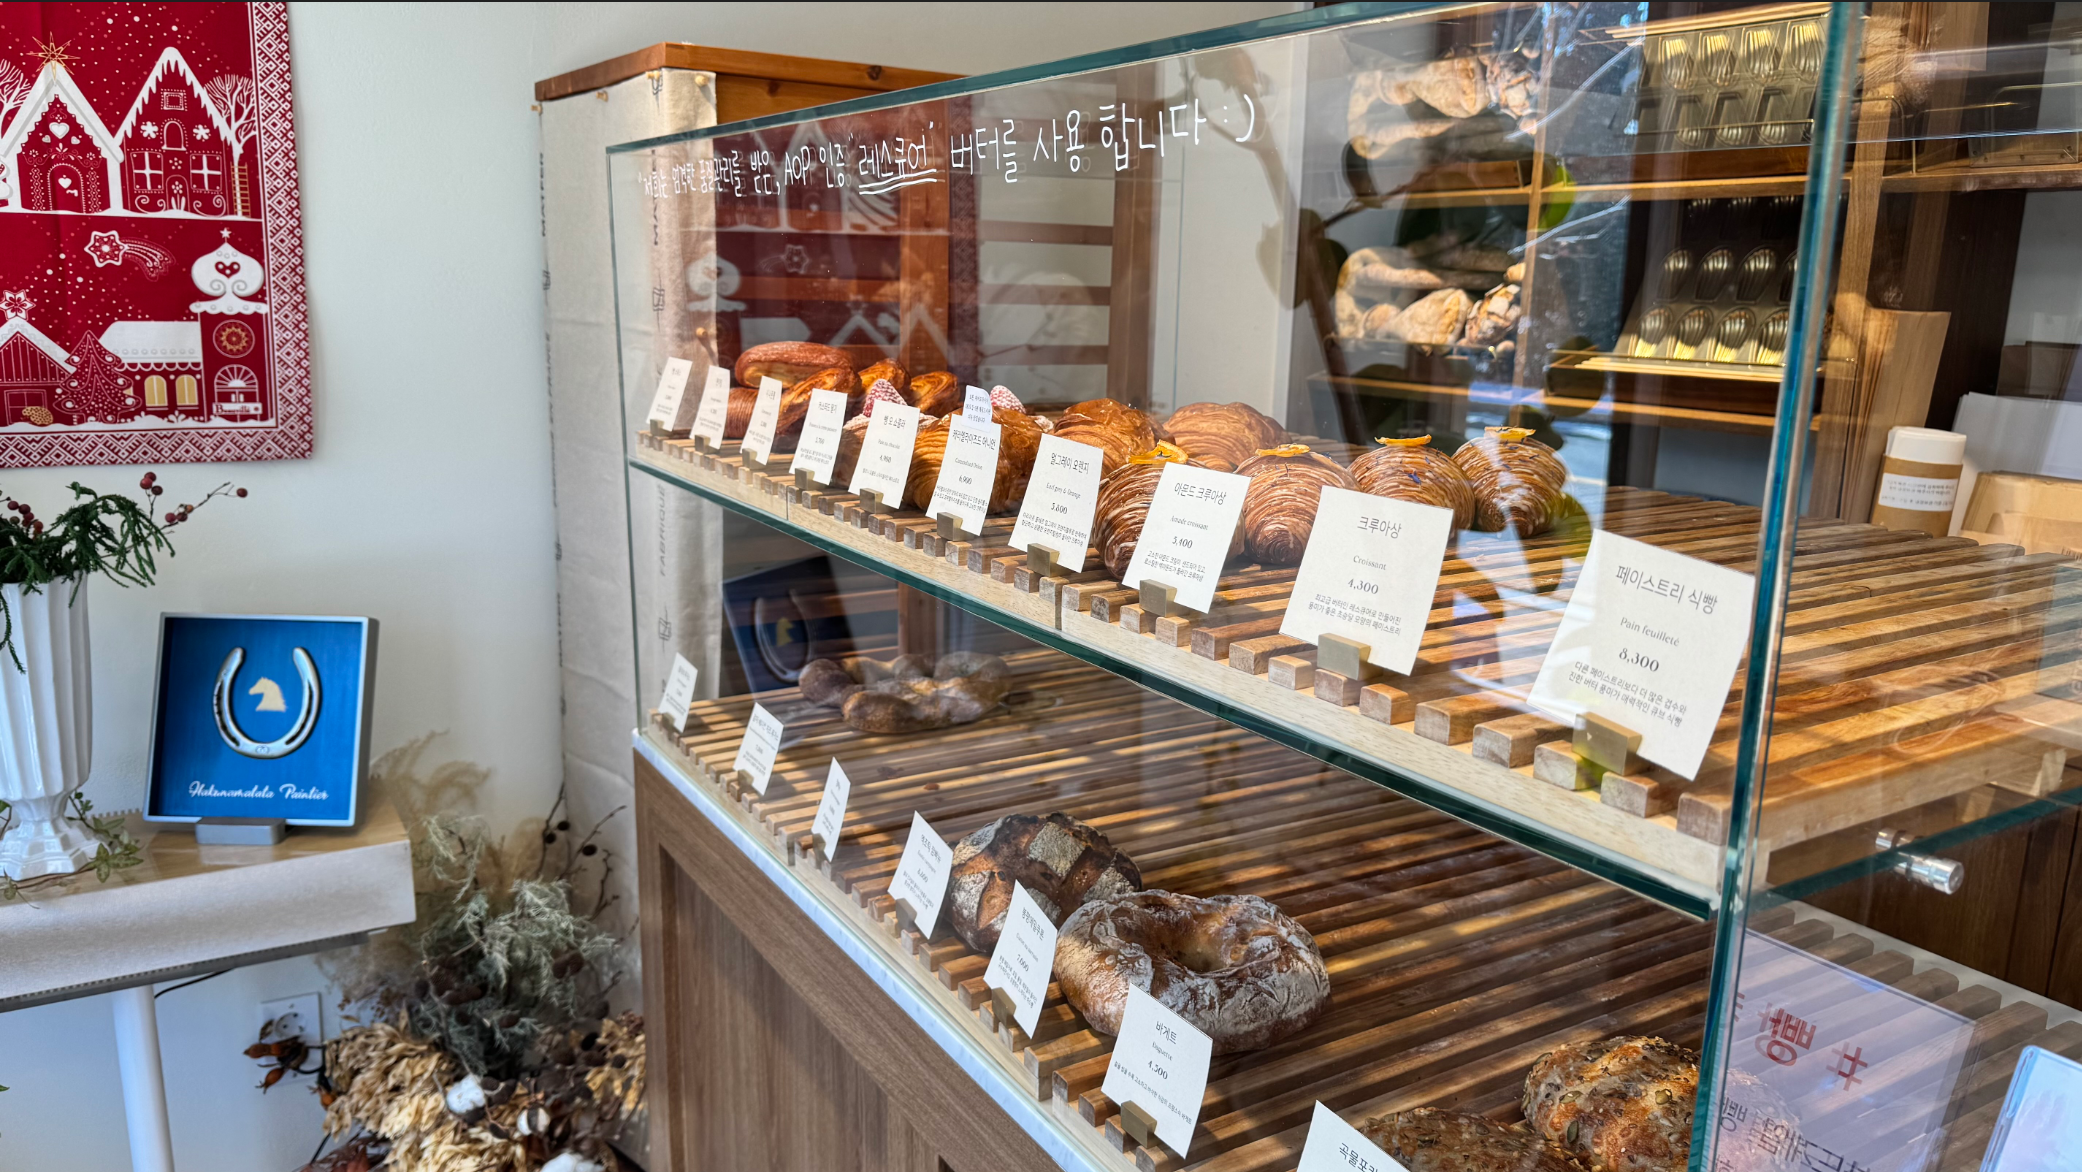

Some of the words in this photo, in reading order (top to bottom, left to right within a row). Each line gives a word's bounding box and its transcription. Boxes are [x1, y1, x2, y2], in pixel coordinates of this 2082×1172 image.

[785, 146, 811, 185] AOP
[951, 119, 1017, 182] 버터를
[1050, 452, 1072, 470] 얼그레이
[1072, 460, 1090, 474] 오렌지
[1174, 482, 1196, 497] 아몬드
[1196, 487, 1227, 505] 크루아상
[1357, 516, 1402, 540] 크루아상
[1353, 555, 1387, 571] Croissant
[1347, 578, 1379, 595] 4,300
[1616, 566, 1684, 603] 페이스트리
[1688, 590, 1718, 615] 식빵
[1308, 601, 1325, 613] 풍미가
[1325, 607, 1336, 617] 좋은
[1337, 610, 1354, 622] 초승달
[1354, 615, 1371, 627] 모양의
[1372, 620, 1401, 636] 페이스트리
[1315, 594, 1331, 605] 최고급
[1332, 599, 1349, 611] 버터인
[1349, 603, 1377, 618] 레스큐어로
[1378, 611, 1401, 626] 만들어진
[1620, 616, 1640, 632] Pain
[1642, 622, 1680, 647] feuilleté
[1618, 647, 1660, 672] 8,300
[1568, 671, 1584, 685] 진한
[1584, 678, 1599, 692] 버터
[1599, 683, 1621, 701] 풍미가
[1621, 693, 1650, 714] 매력적인
[1650, 706, 1666, 720] 큐브
[1667, 713, 1683, 728] 식빵
[1574, 661, 1590, 674] 다른
[1590, 667, 1639, 695] 페이스트리보다
[1639, 688, 1648, 699] 더
[1647, 691, 1664, 706] 많은
[1664, 698, 1687, 715] 겹수와
[1155, 1021, 1177, 1044] 바게트
[1152, 1041, 1173, 1061] Baguette
[1148, 1060, 1168, 1080] 4,500
